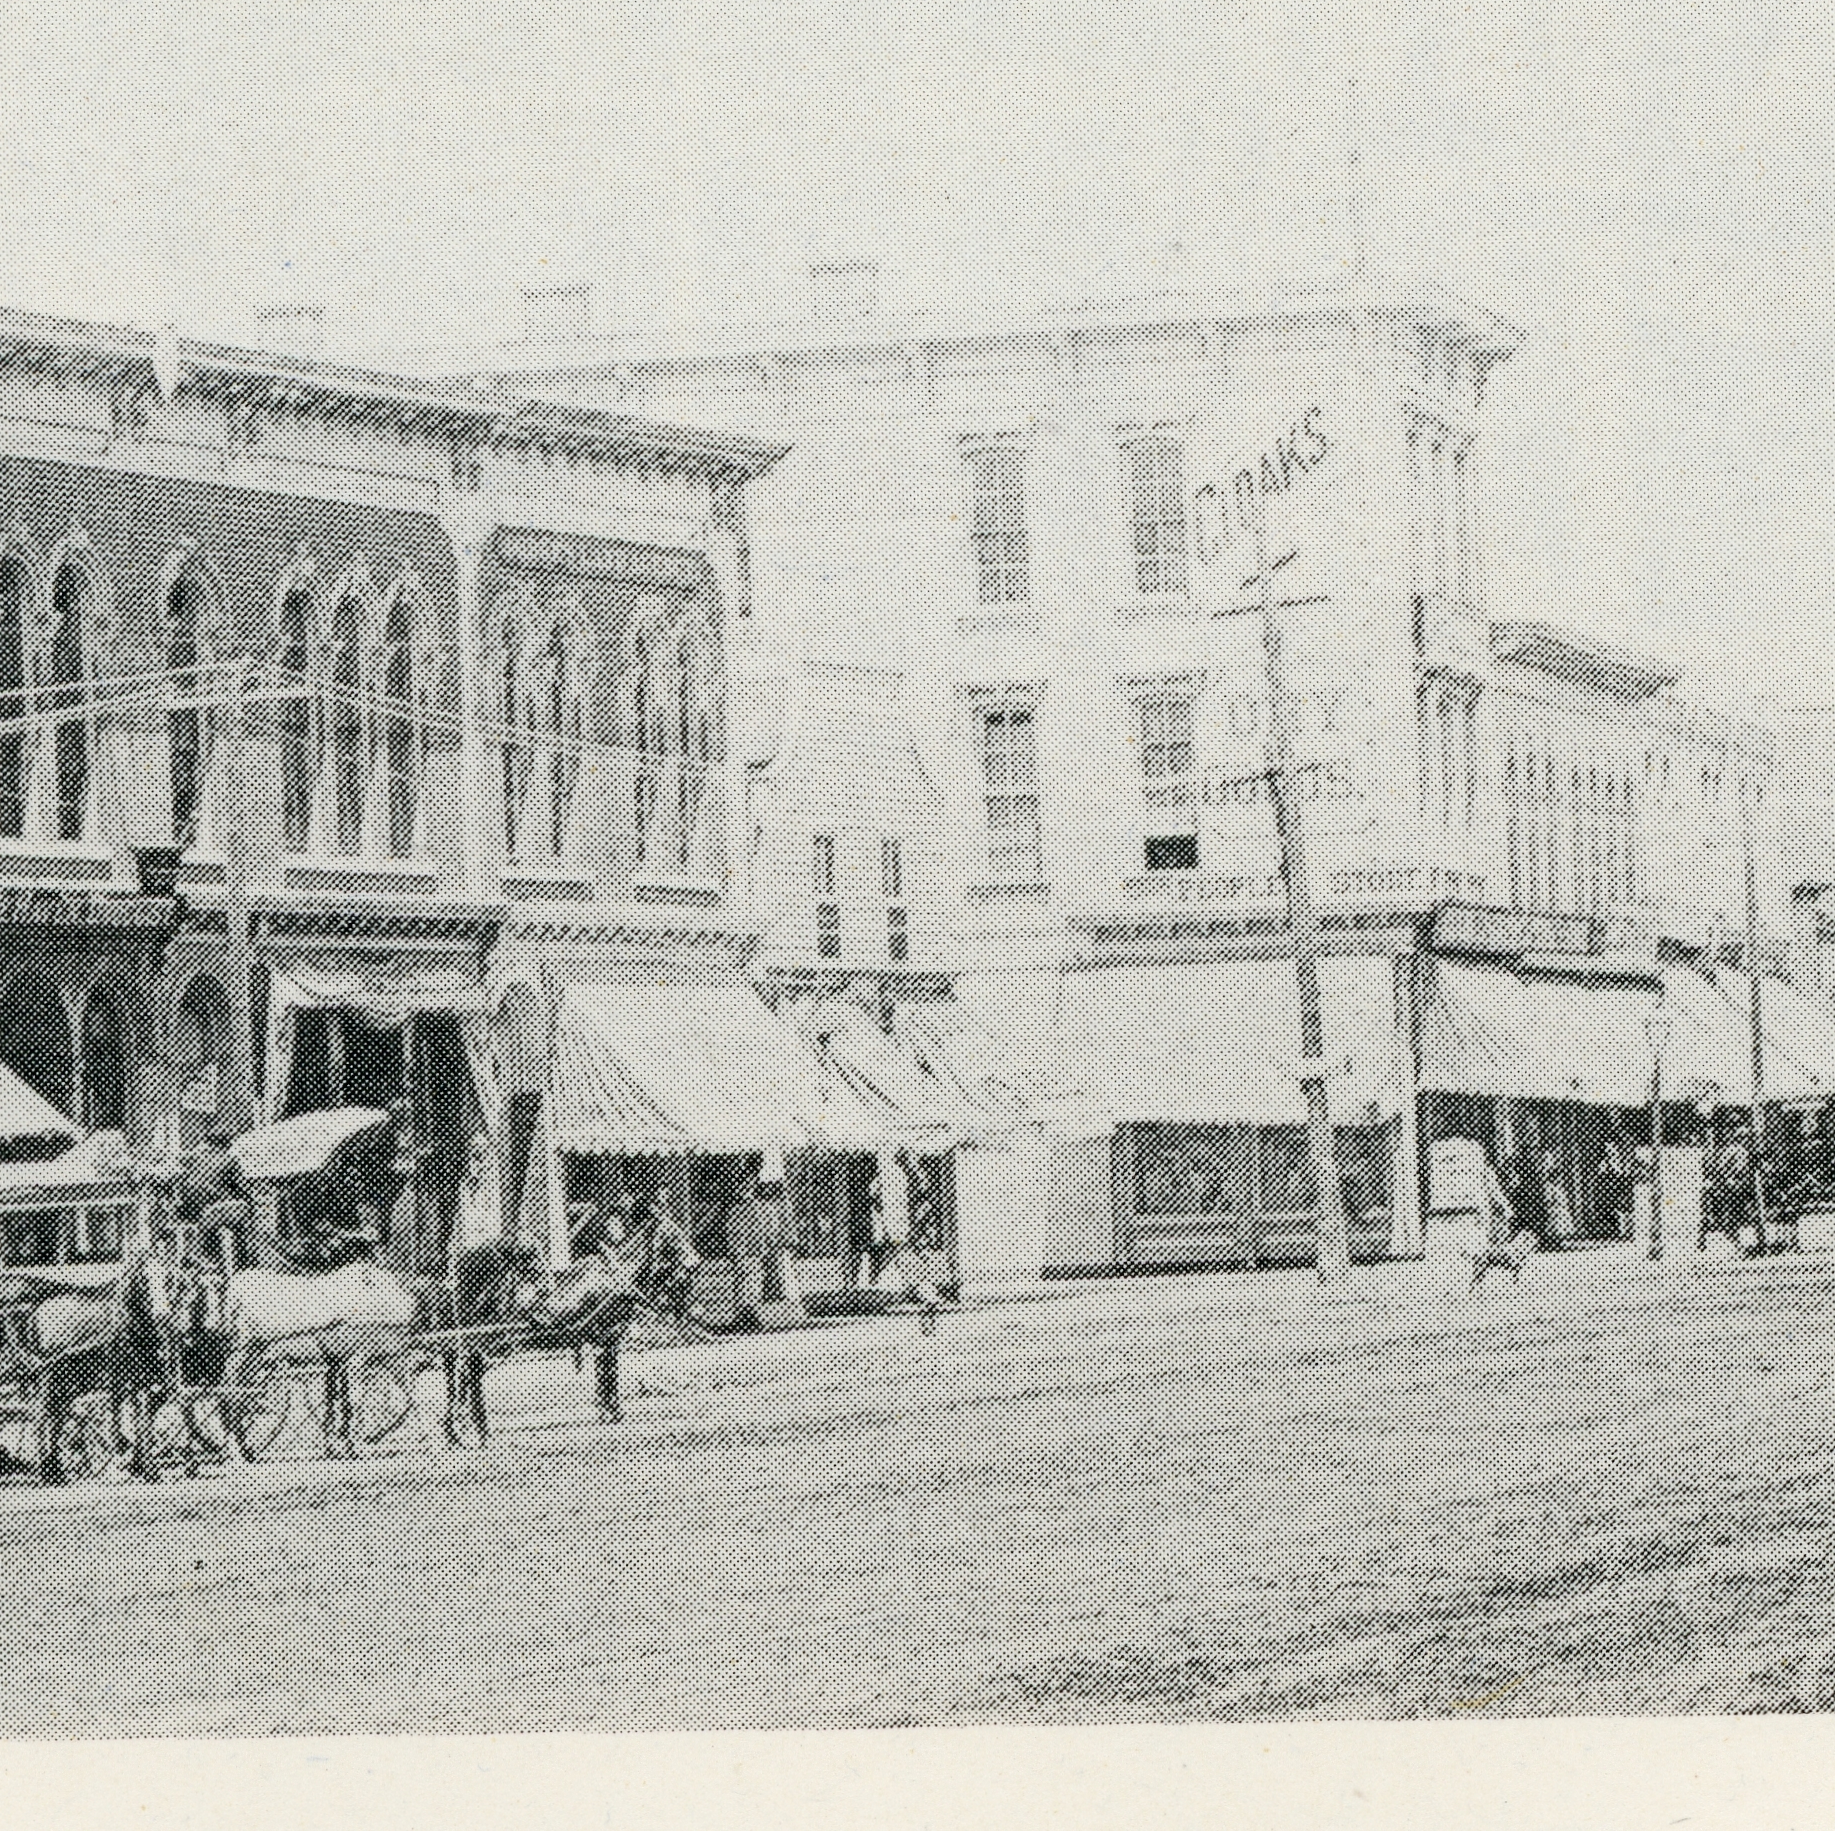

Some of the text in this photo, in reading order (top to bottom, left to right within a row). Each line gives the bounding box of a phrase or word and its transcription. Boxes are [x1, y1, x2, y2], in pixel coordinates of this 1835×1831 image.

[1192, 404, 1332, 567] CLOAKS
[1226, 685, 1349, 740] DRY
[1202, 757, 1366, 808] GODS.
